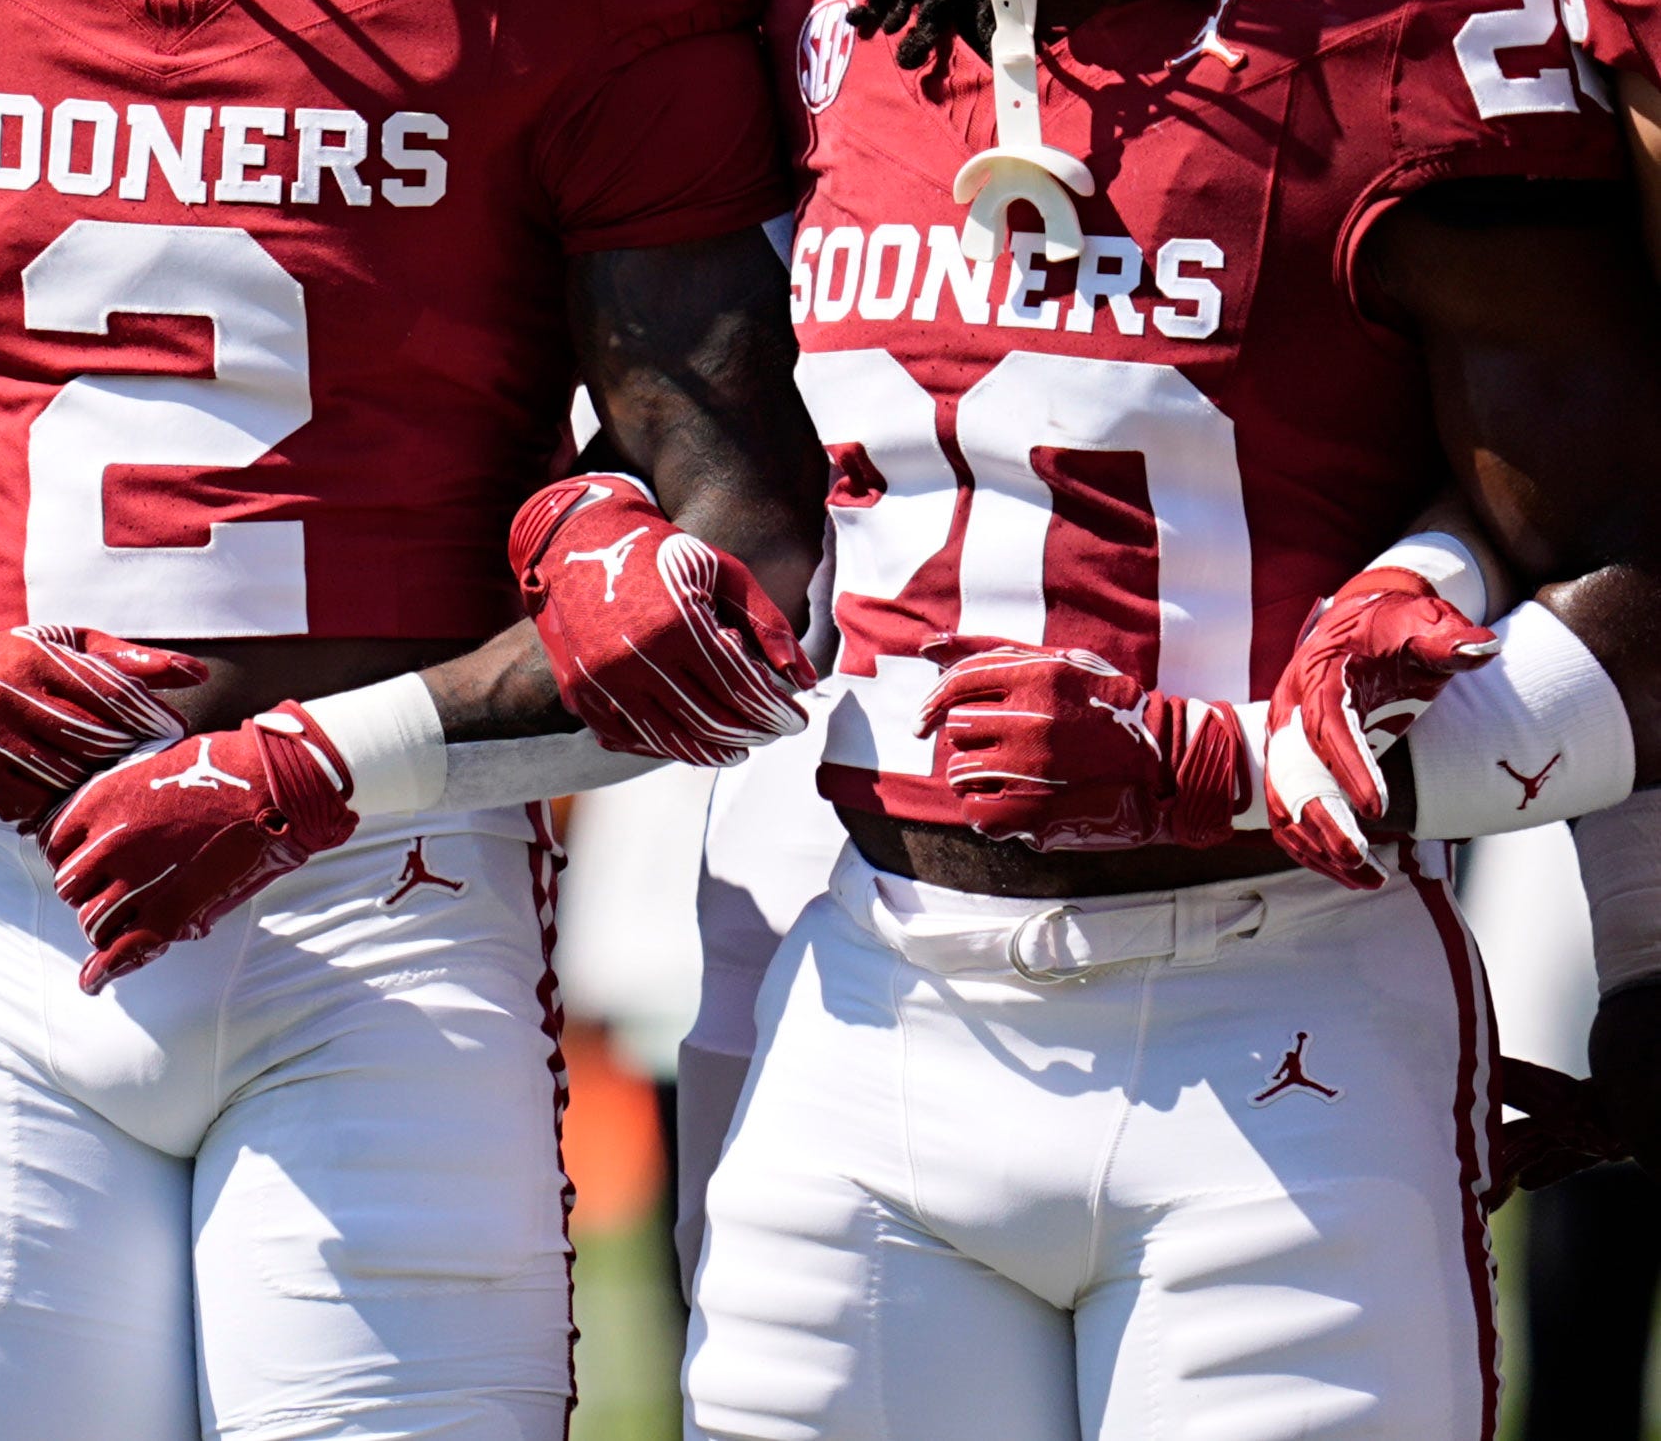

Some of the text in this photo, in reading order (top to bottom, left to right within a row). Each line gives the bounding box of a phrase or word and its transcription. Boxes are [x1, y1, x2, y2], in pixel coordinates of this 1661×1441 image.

[802, 2, 850, 103] SEC
[790, 224, 1225, 340] SOONERS
[23, 220, 312, 640] 2
[792, 348, 1253, 777] 20
